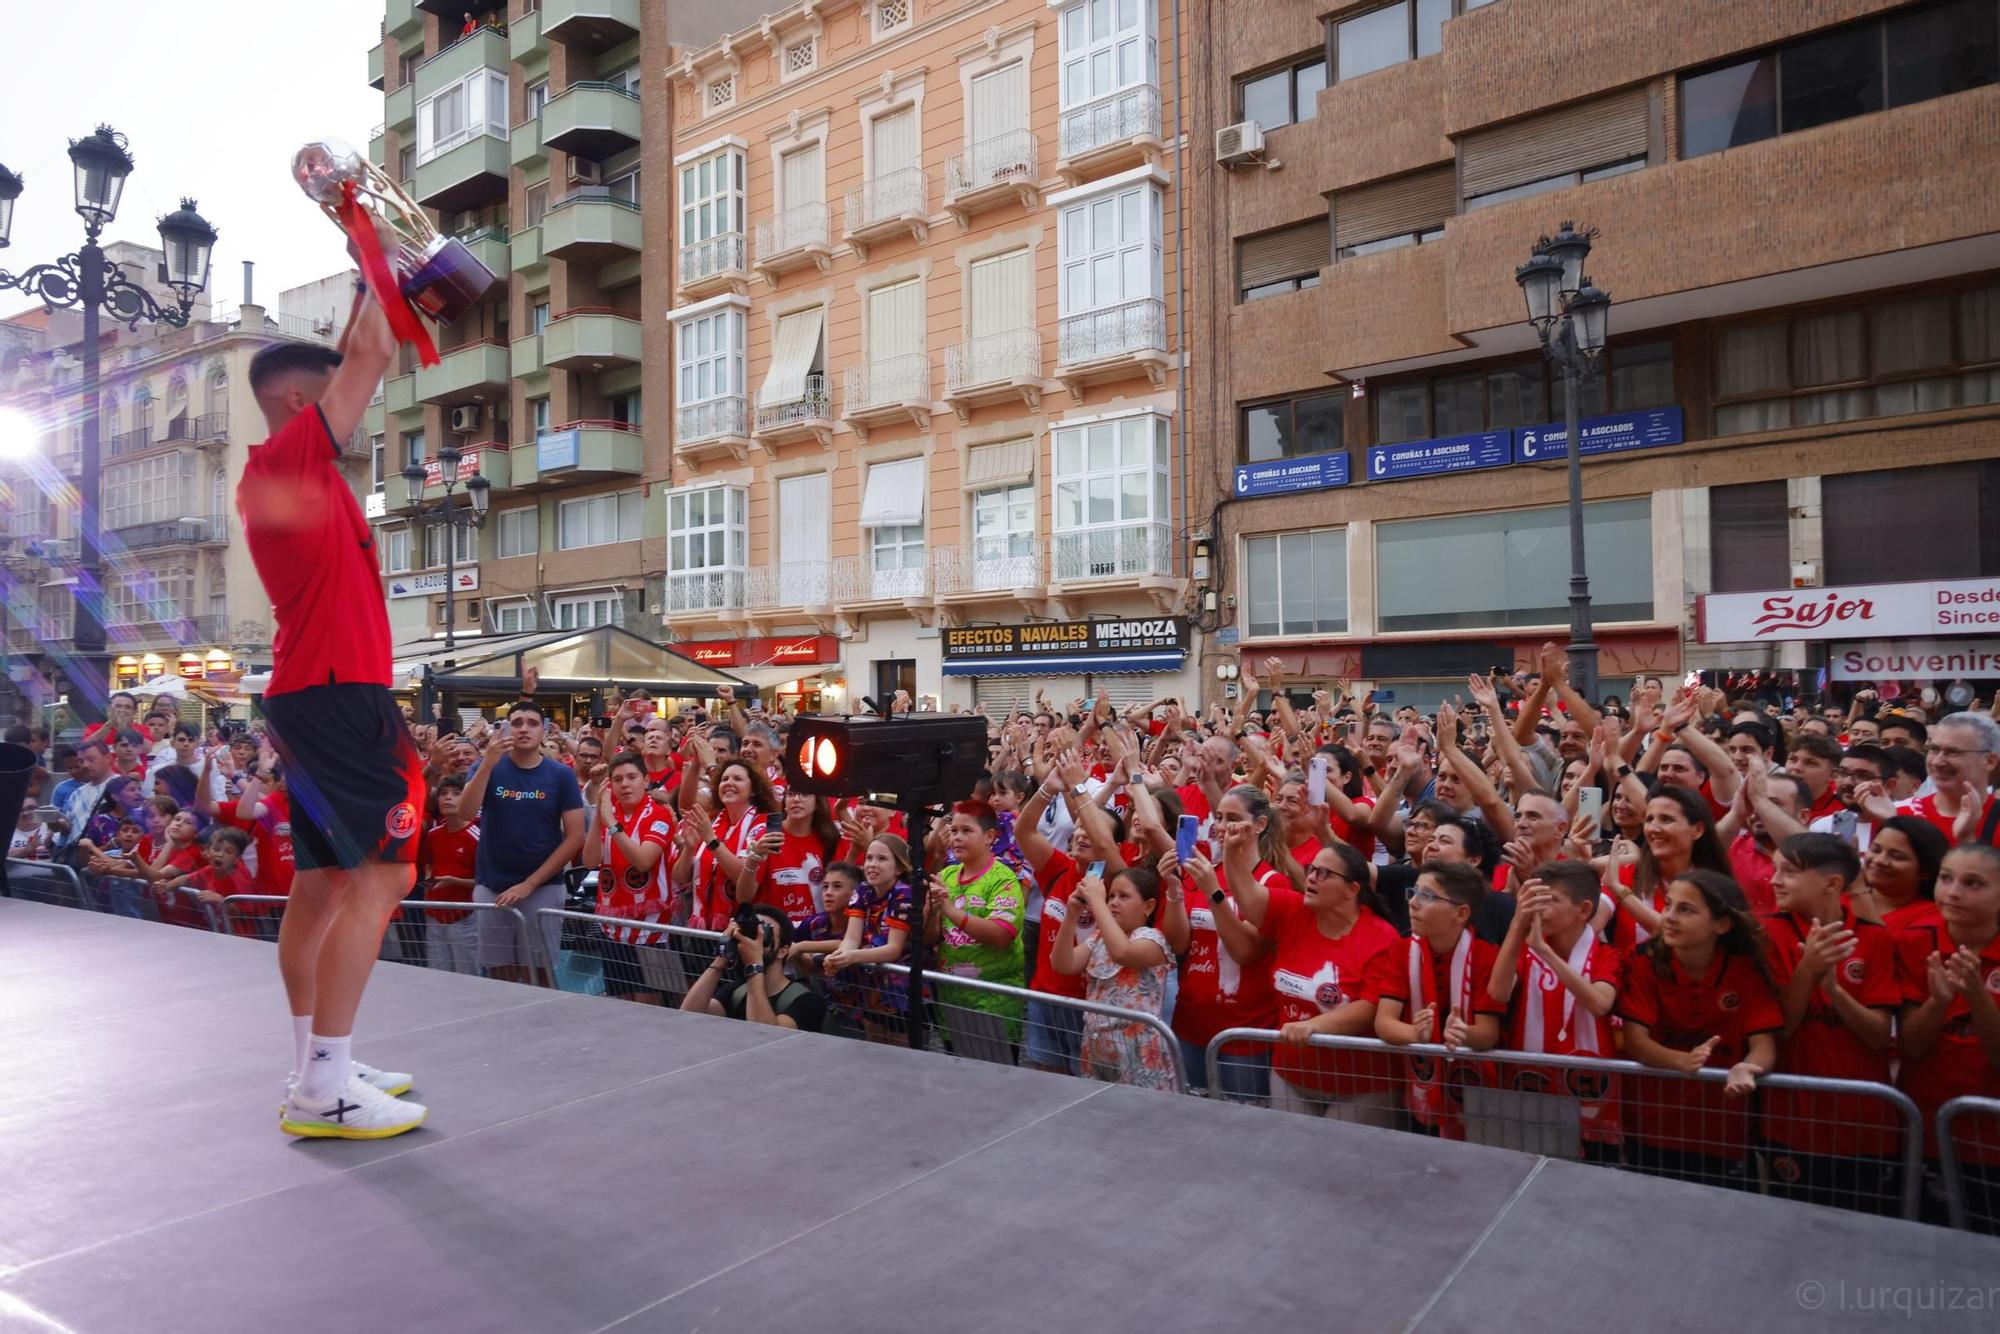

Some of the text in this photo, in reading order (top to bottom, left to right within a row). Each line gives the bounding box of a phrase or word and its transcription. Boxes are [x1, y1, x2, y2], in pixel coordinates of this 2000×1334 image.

[1543, 429, 1569, 442] COMU
[1582, 425, 1588, 437] &
[1591, 422, 1634, 436] ASOCIADOS
[1425, 448, 1431, 456] &
[1433, 444, 1470, 455] ASOCIADOS
[1288, 464, 1320, 475] ASOCIADOS
[415, 574, 449, 589] BLAZQUE
[1751, 593, 1875, 637] Sajor
[1937, 609, 2000, 625] Since
[949, 619, 1178, 646] EFECTOS NAVALES MENDOZA
[495, 786, 546, 801] Spagnolo
